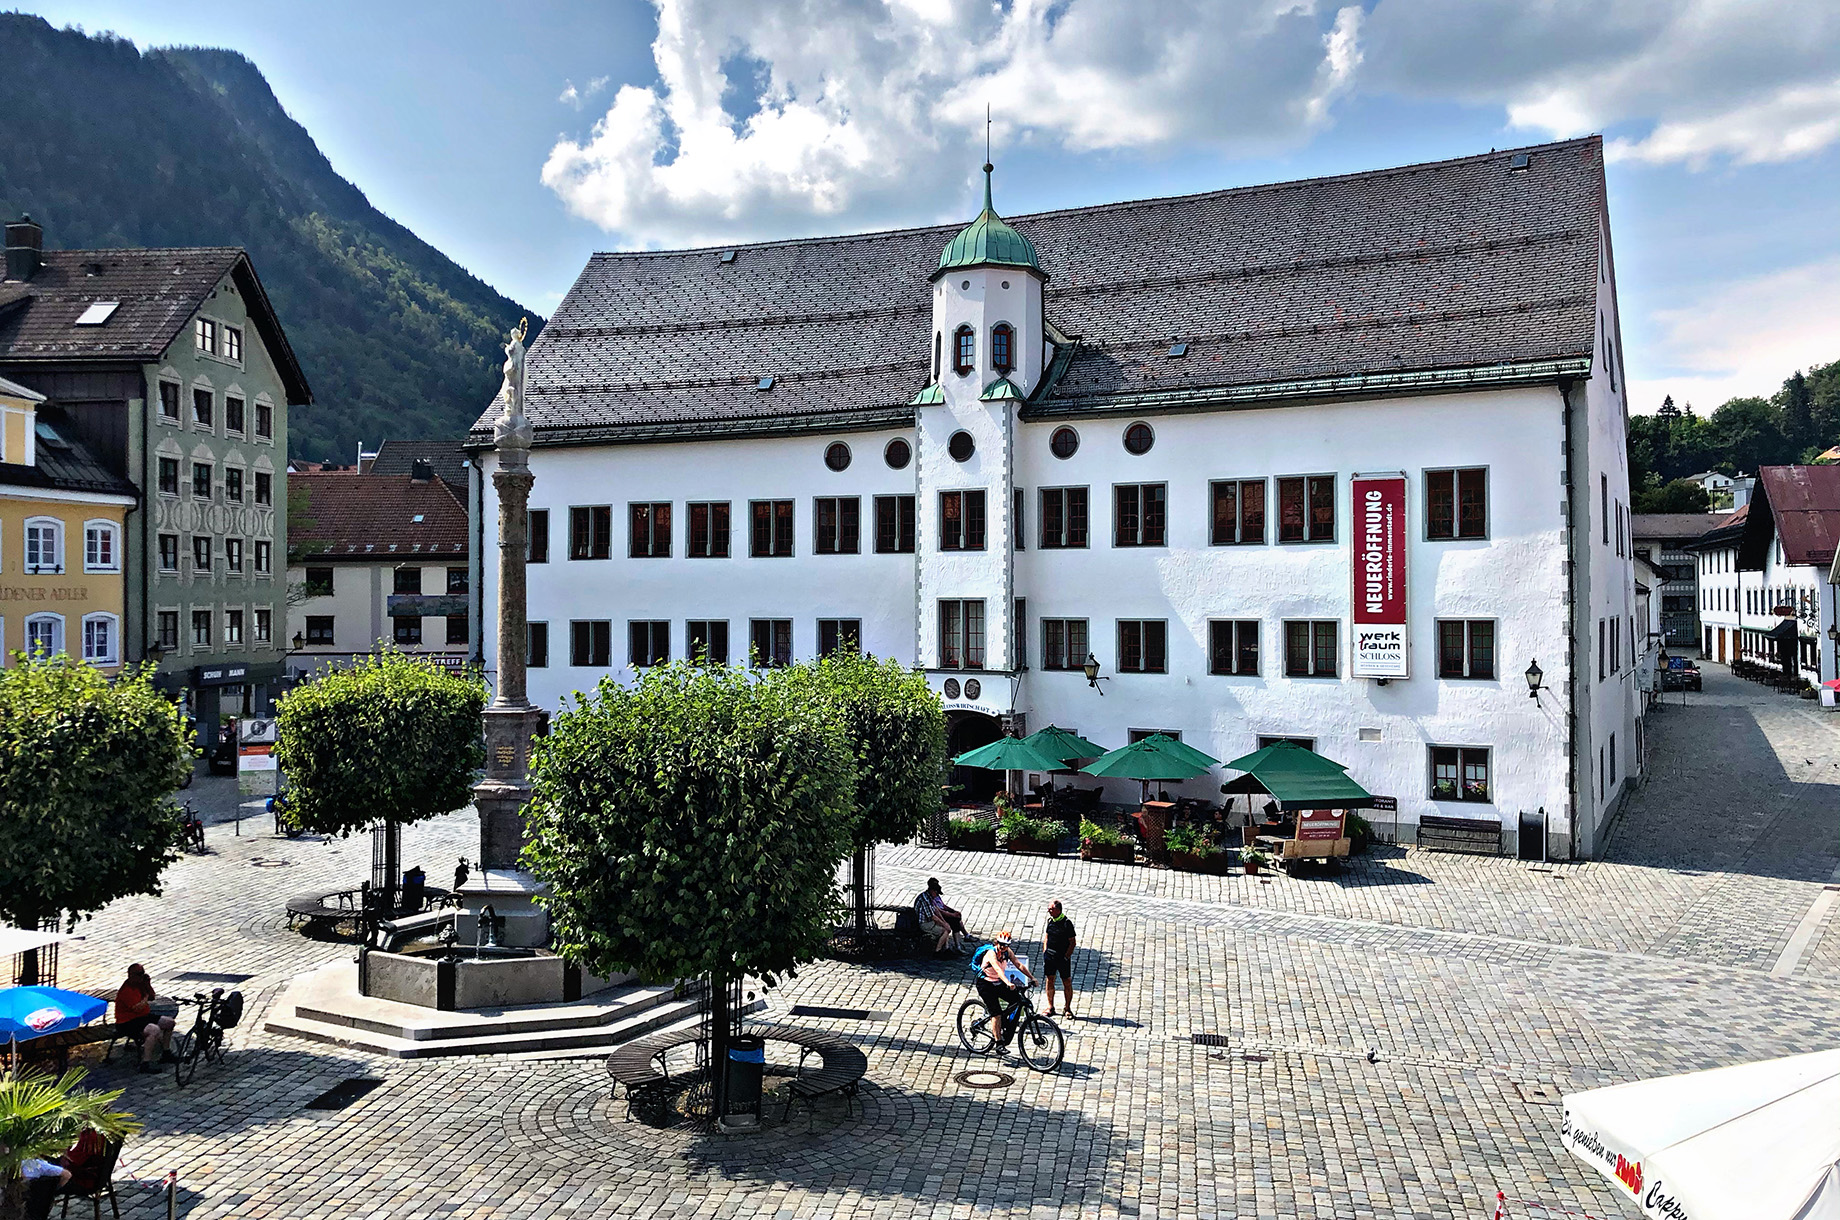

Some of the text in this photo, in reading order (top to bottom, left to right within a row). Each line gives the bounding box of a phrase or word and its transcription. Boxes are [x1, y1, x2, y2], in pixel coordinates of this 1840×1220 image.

[1361, 490, 1383, 613] NEUERÖFFNUNG
[50, 587, 88, 600] ADLER
[1360, 631, 1400, 641] werk
[1359, 652, 1401, 661] SCHLOSS
[1572, 1129, 1605, 1159] genießen
